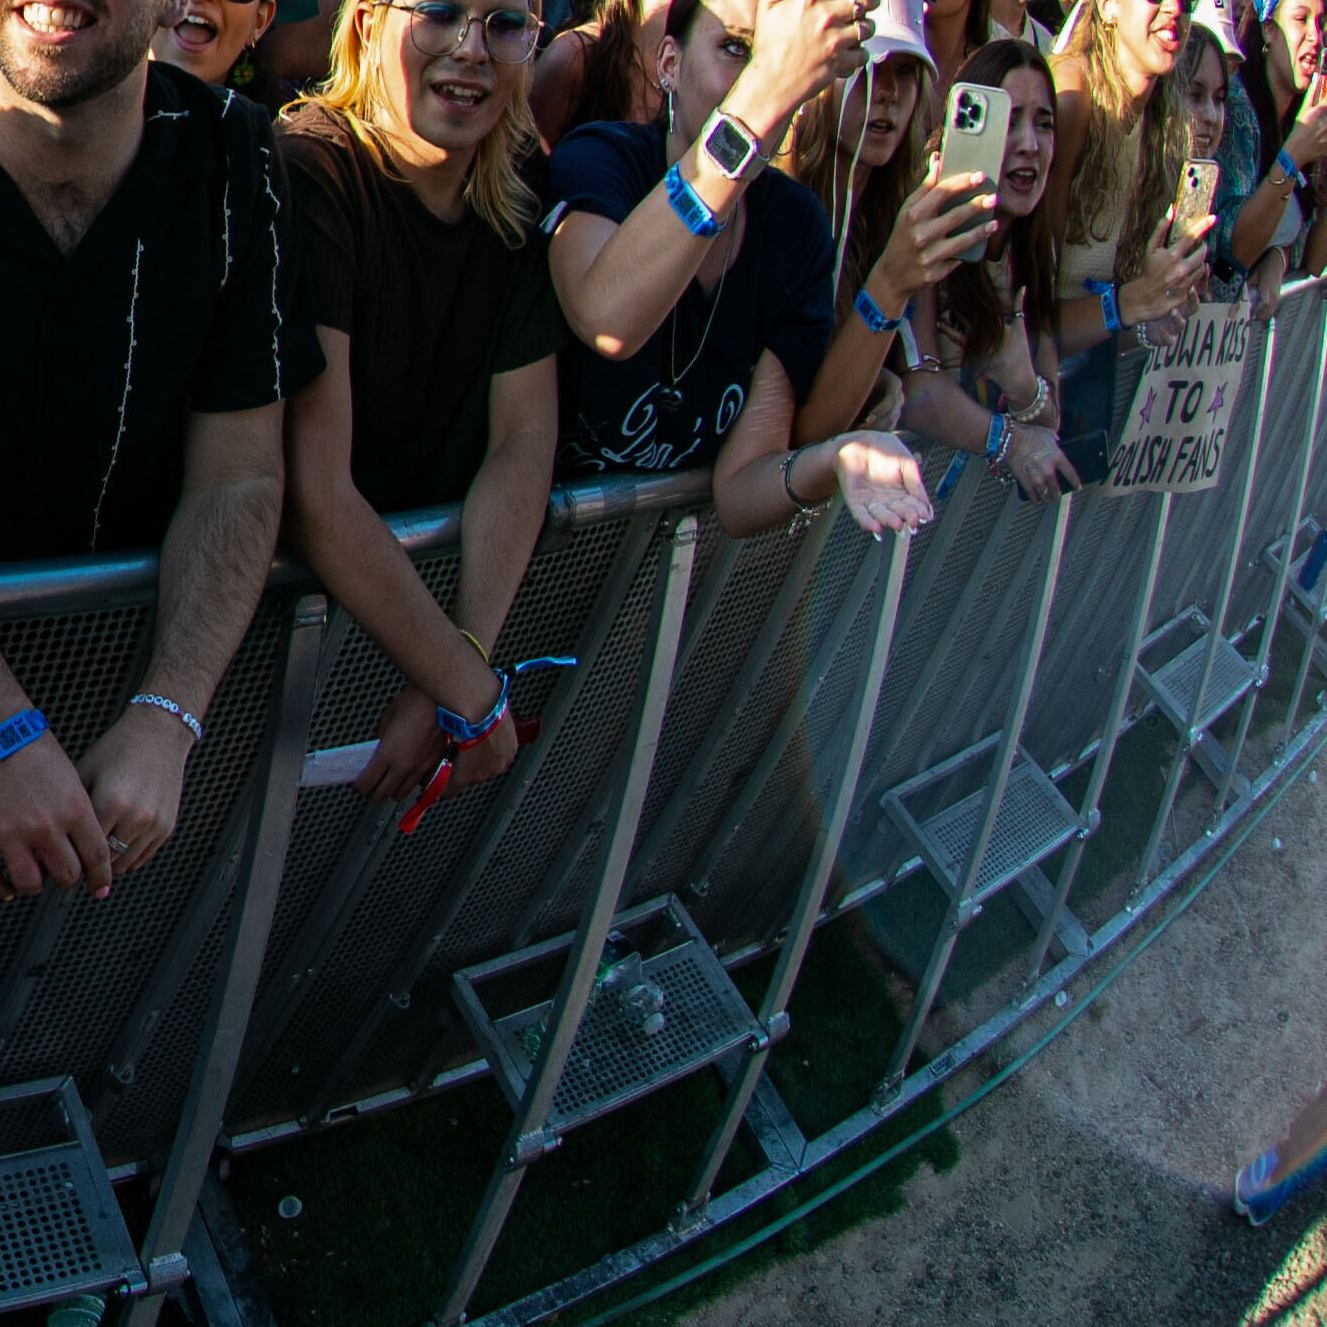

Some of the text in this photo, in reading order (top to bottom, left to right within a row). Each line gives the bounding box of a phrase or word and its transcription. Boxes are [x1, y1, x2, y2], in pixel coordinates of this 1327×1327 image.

[1215, 318, 1248, 366] KISS
[1165, 380, 1204, 425] TO
[1166, 428, 1224, 484] FANS
